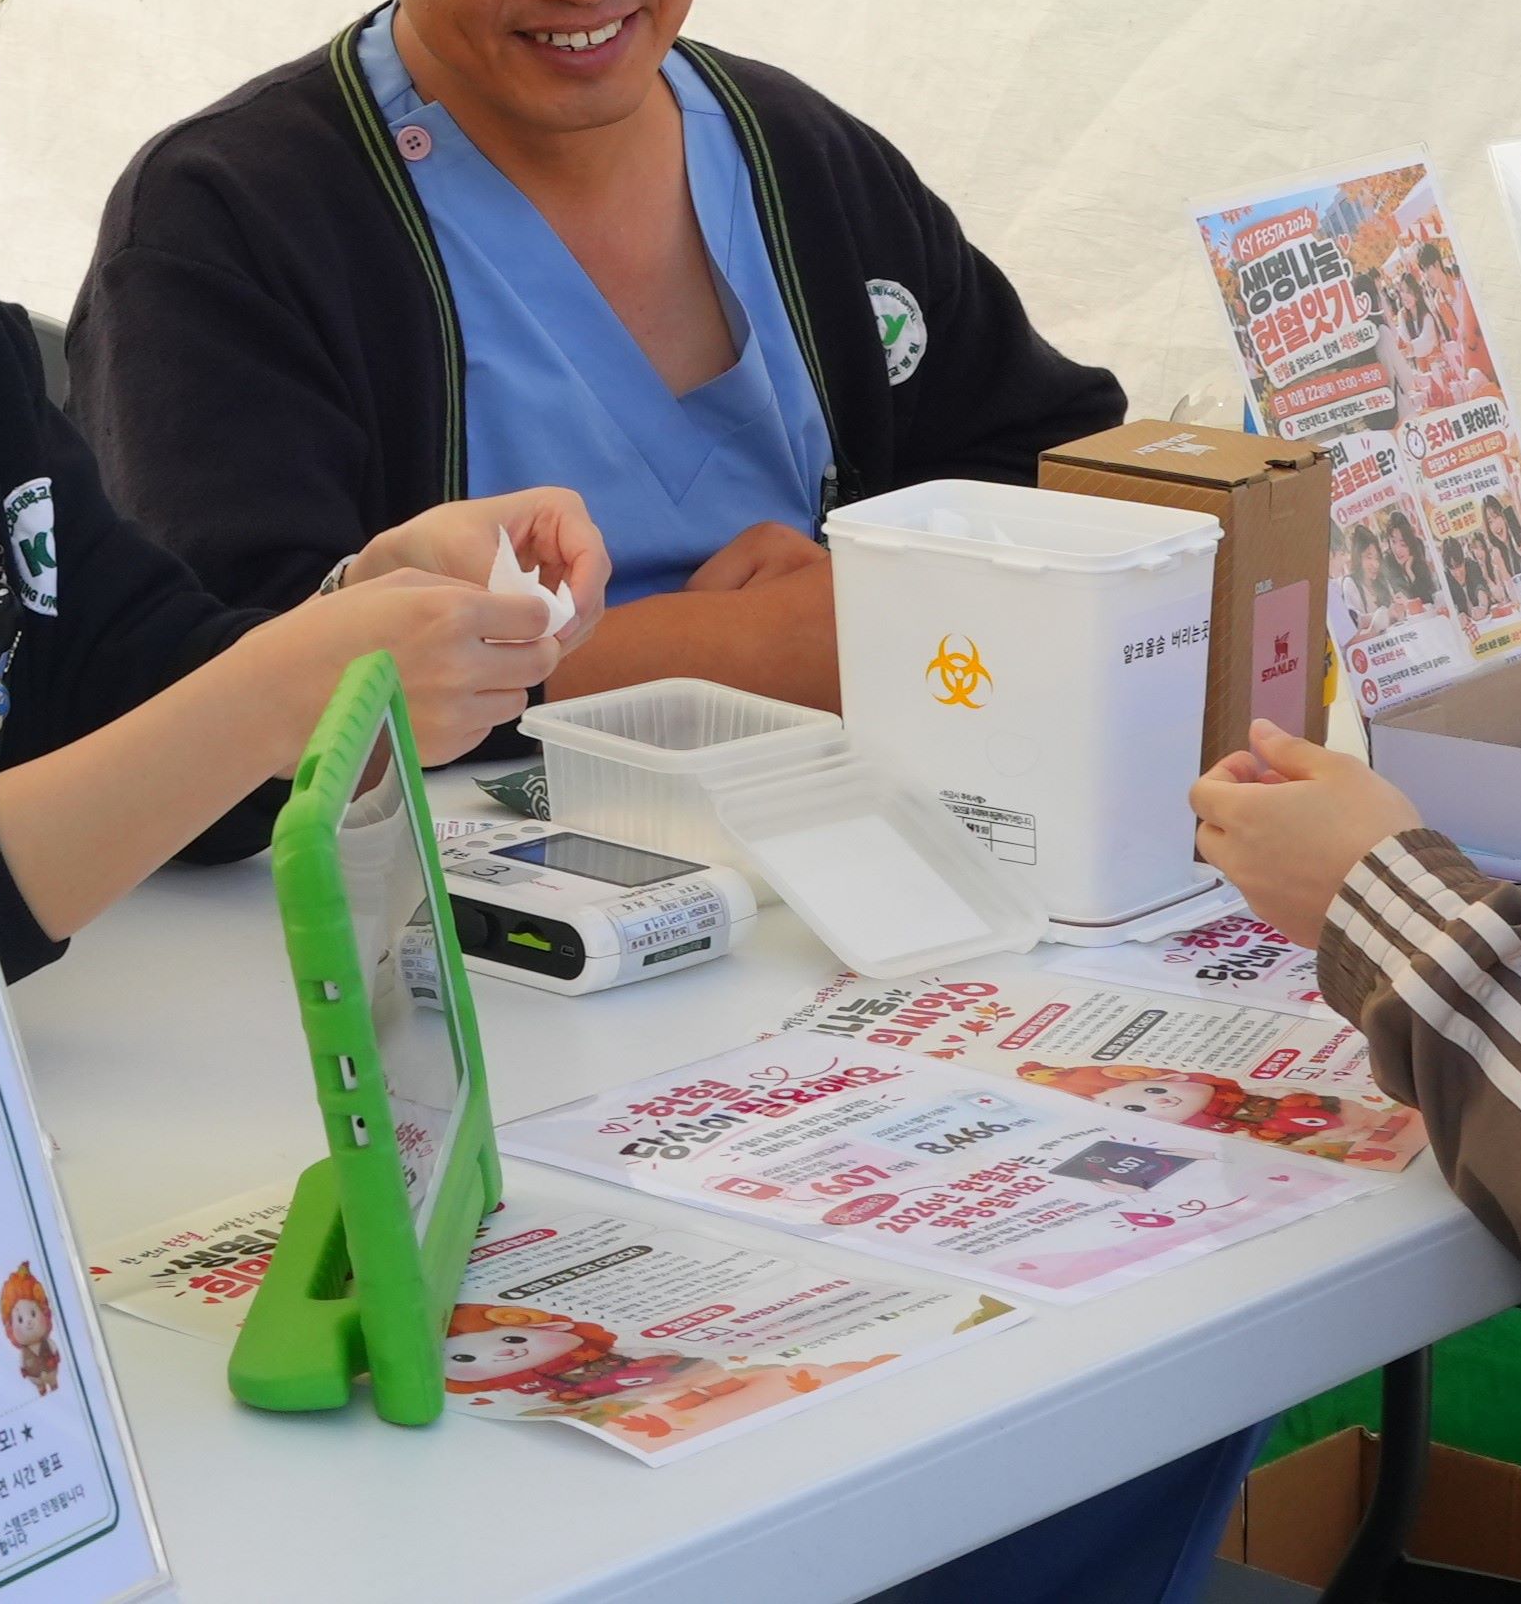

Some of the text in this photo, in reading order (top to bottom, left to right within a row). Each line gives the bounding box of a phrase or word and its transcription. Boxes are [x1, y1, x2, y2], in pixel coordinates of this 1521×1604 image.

[1237, 213, 1312, 259] KY FESTA 2026
[1241, 241, 1351, 314] 생명나눔,
[1251, 279, 1360, 365] 헌혈잇기
[1123, 635, 1165, 664] 알코올솜
[1261, 657, 1299, 683] STANLEY
[1196, 944, 1292, 981] 당신이
[890, 991, 979, 1029] 씨앗
[619, 1066, 903, 1160] 당신이 필요해요
[627, 1079, 765, 1117] 헌혈,
[914, 1121, 1011, 1155] 8,466
[811, 1164, 891, 1196] 607
[1107, 1156, 1146, 1174] 6.07
[876, 1193, 965, 1234] 2026년
[948, 1156, 1047, 1192] 헌혈자는
[930, 1175, 1055, 1229] 몇명일까요?
[595, 1247, 645, 1268] CHECK!
[13, 1463, 36, 1489] 시간
[38, 1452, 63, 1479] 발표
